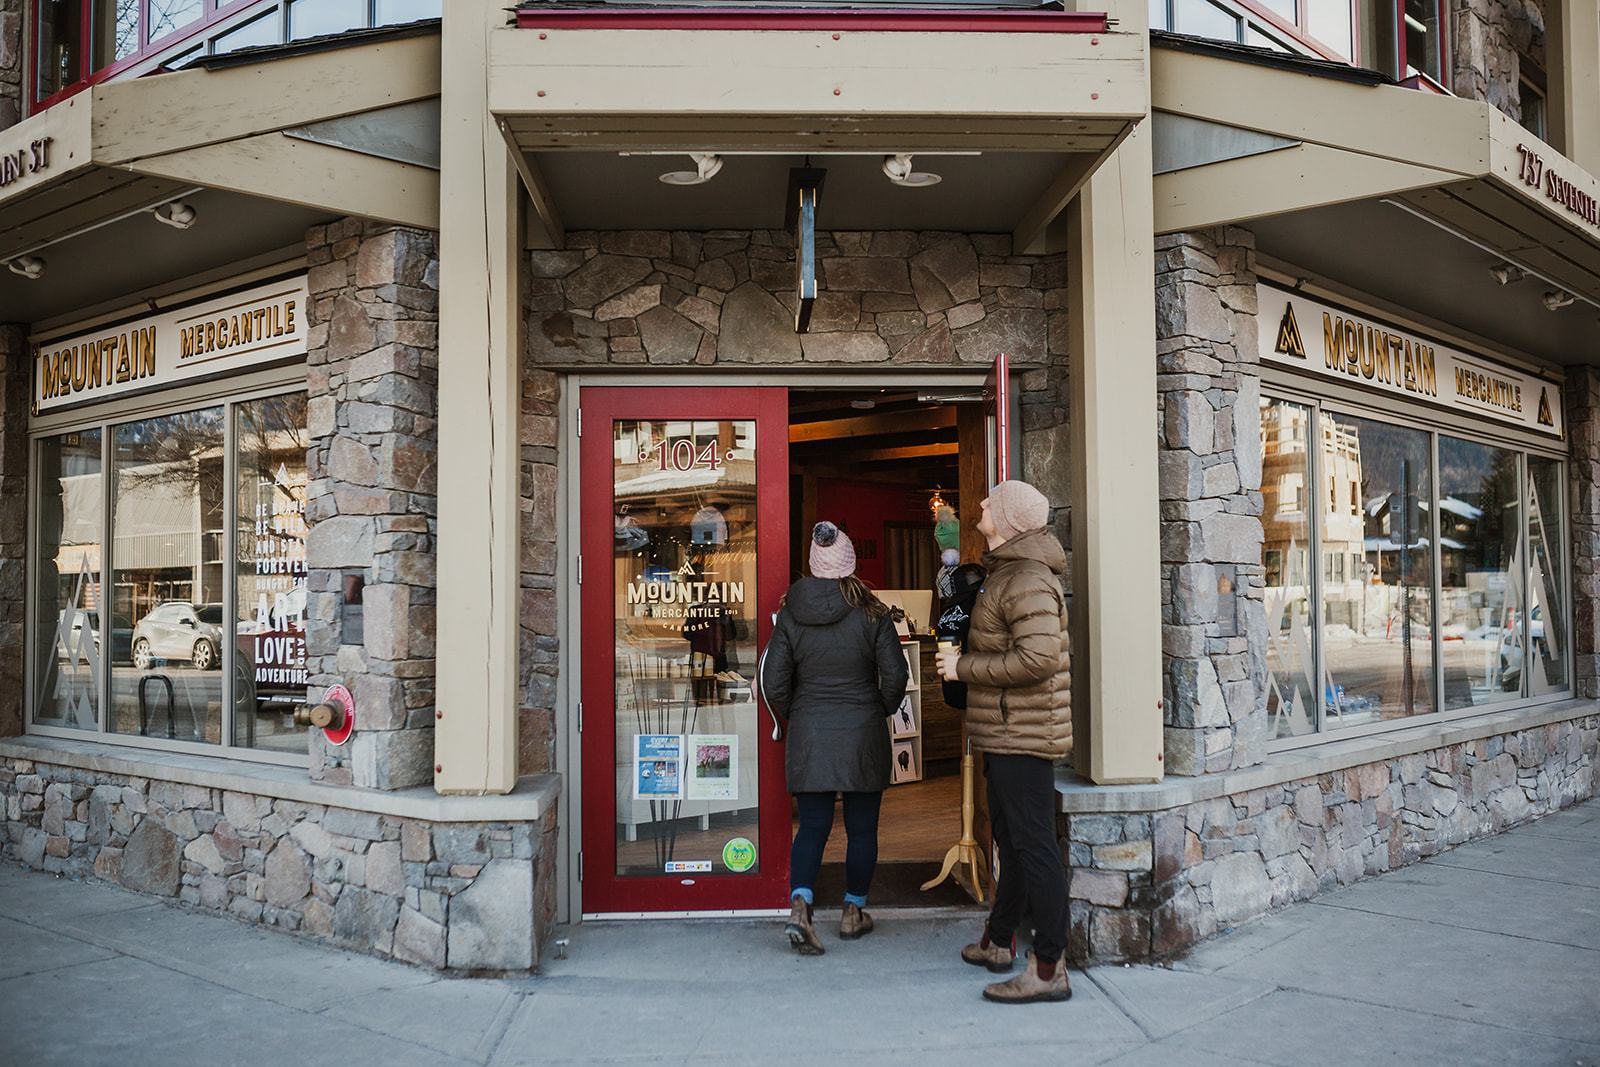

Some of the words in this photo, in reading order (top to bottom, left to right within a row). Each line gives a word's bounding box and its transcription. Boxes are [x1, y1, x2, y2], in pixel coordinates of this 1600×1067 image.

[0, 149, 25, 187] IN
[29, 136, 54, 173] ST
[1516, 143, 1544, 189] 737
[1545, 169, 1600, 226] SEVENTH
[180, 301, 296, 359] MERCANTILE
[41, 326, 156, 400] MOUNTAIN
[1322, 311, 1437, 397] MOUNTAIN
[1454, 366, 1522, 412] MERCANTILE
[655, 439, 721, 472] 104
[256, 521, 268, 535] BE
[256, 540, 275, 553] AND
[256, 557, 309, 575] FOREVER
[627, 581, 744, 604] MOUNTAIN
[653, 608, 720, 618] MERCANTILE
[662, 621, 710, 632] CANMORE
[255, 636, 295, 665] LOVE
[297, 638, 305, 665] AND
[256, 667, 308, 684] ADVENTURE
